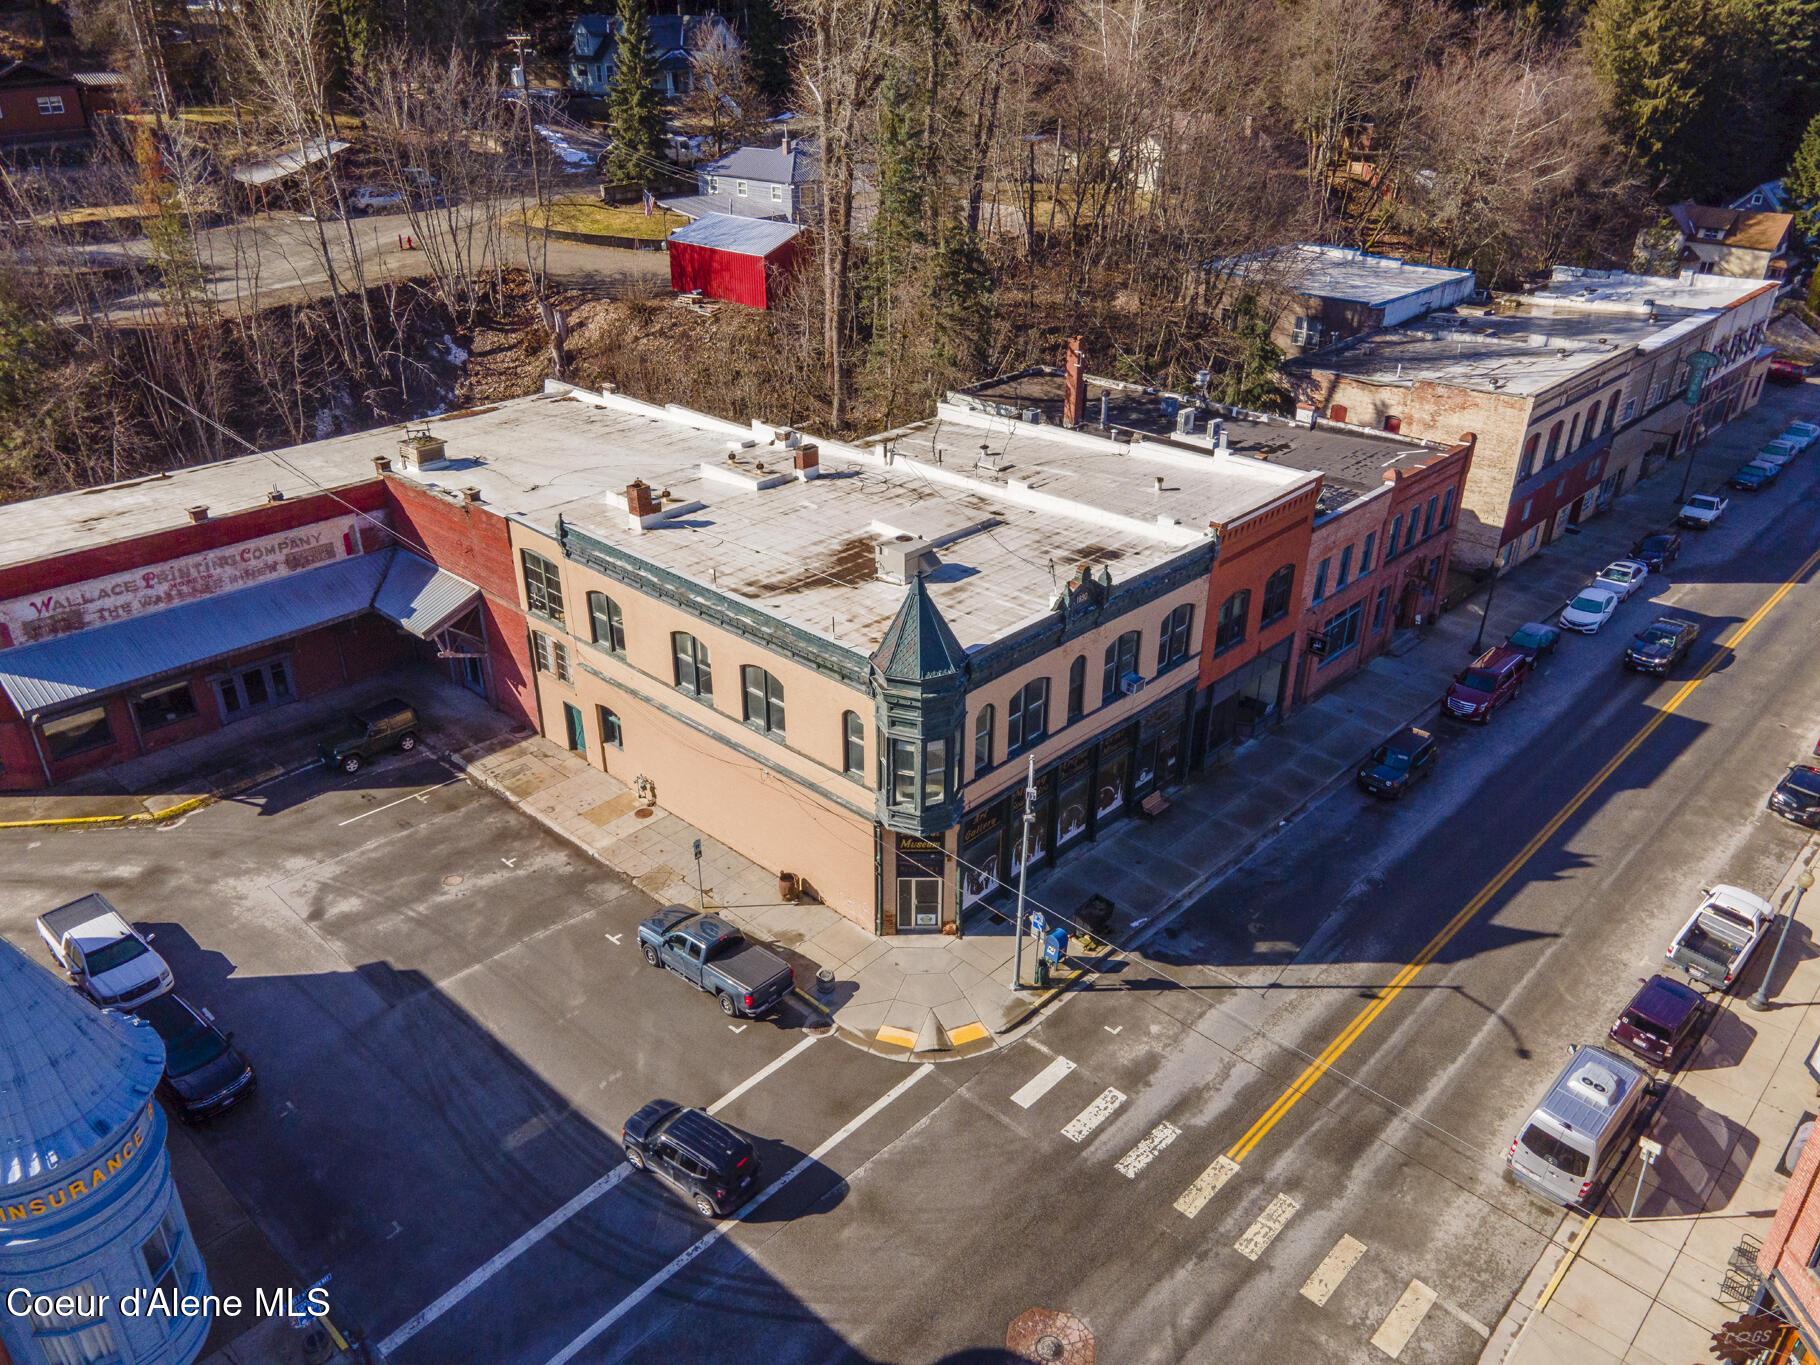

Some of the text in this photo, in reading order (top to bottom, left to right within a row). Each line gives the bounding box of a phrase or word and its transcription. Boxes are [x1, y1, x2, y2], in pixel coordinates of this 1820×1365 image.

[29, 580, 140, 617] WALLACE
[240, 532, 322, 562] COMPANY
[900, 838, 941, 849] Museum
[0, 1126, 144, 1224] INSURANCE
